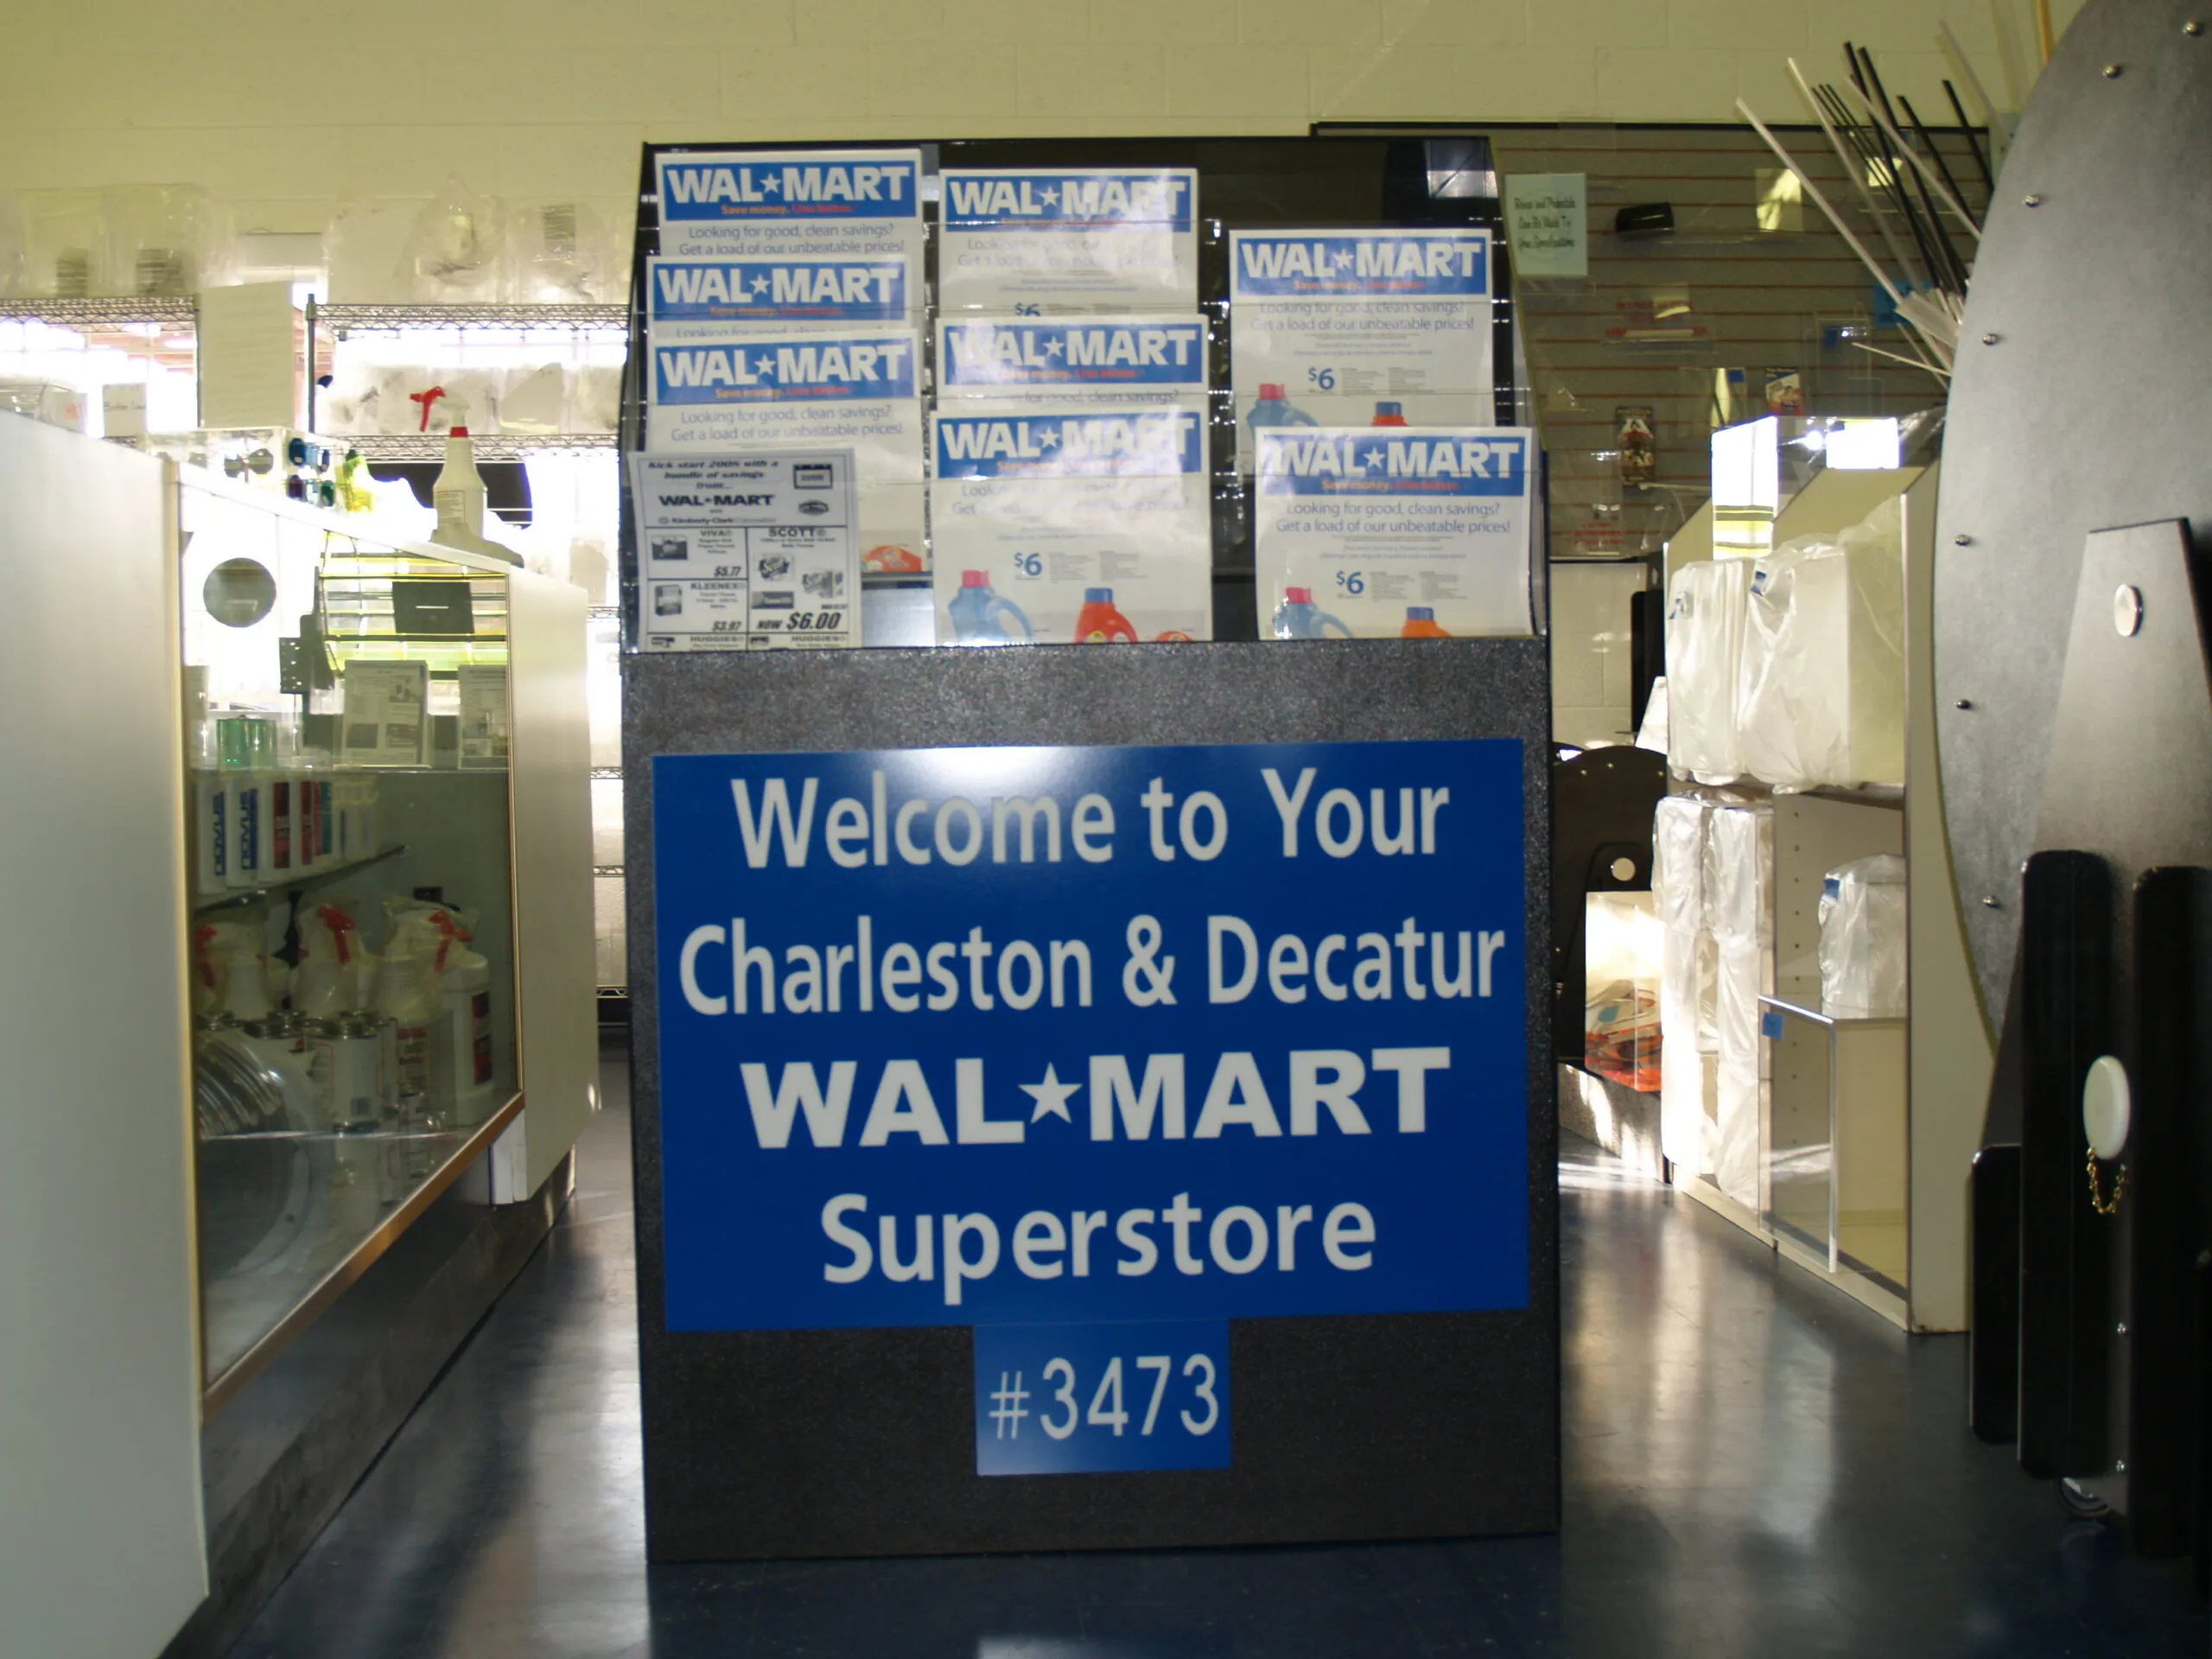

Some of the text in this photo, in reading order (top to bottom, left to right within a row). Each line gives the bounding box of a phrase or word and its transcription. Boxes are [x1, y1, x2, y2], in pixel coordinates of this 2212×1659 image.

[689, 221, 894, 240] Looking for good, clean savings?
[679, 239, 905, 256] Get a load of our unbeatable prices!
[1376, 300, 1408, 313] clean
[1275, 321, 1285, 331] a
[1287, 318, 1315, 331] load
[1318, 318, 1333, 330] of
[1336, 321, 1356, 330] our
[1359, 318, 1431, 330] unbeatable
[1434, 317, 1474, 334] prices!
[1307, 366, 1336, 391] $6
[681, 410, 734, 427] Looking
[737, 410, 756, 423] for
[800, 406, 835, 420] clean
[838, 404, 892, 422] savings?
[671, 422, 902, 442] Get a load of our unbeatable prices!
[1287, 500, 1500, 518] Looking for good, clean savings?
[1276, 519, 1510, 535] Get a load of our unbeatable prices!
[1014, 551, 1043, 575] $6
[1336, 570, 1365, 594] $6
[785, 611, 841, 631] $6.00
[731, 766, 1450, 869] Welcome to Your
[679, 913, 1505, 1016] Charleston & Decatur
[820, 1190, 1376, 1306] Superstore
[988, 1352, 1220, 1441] #3473
